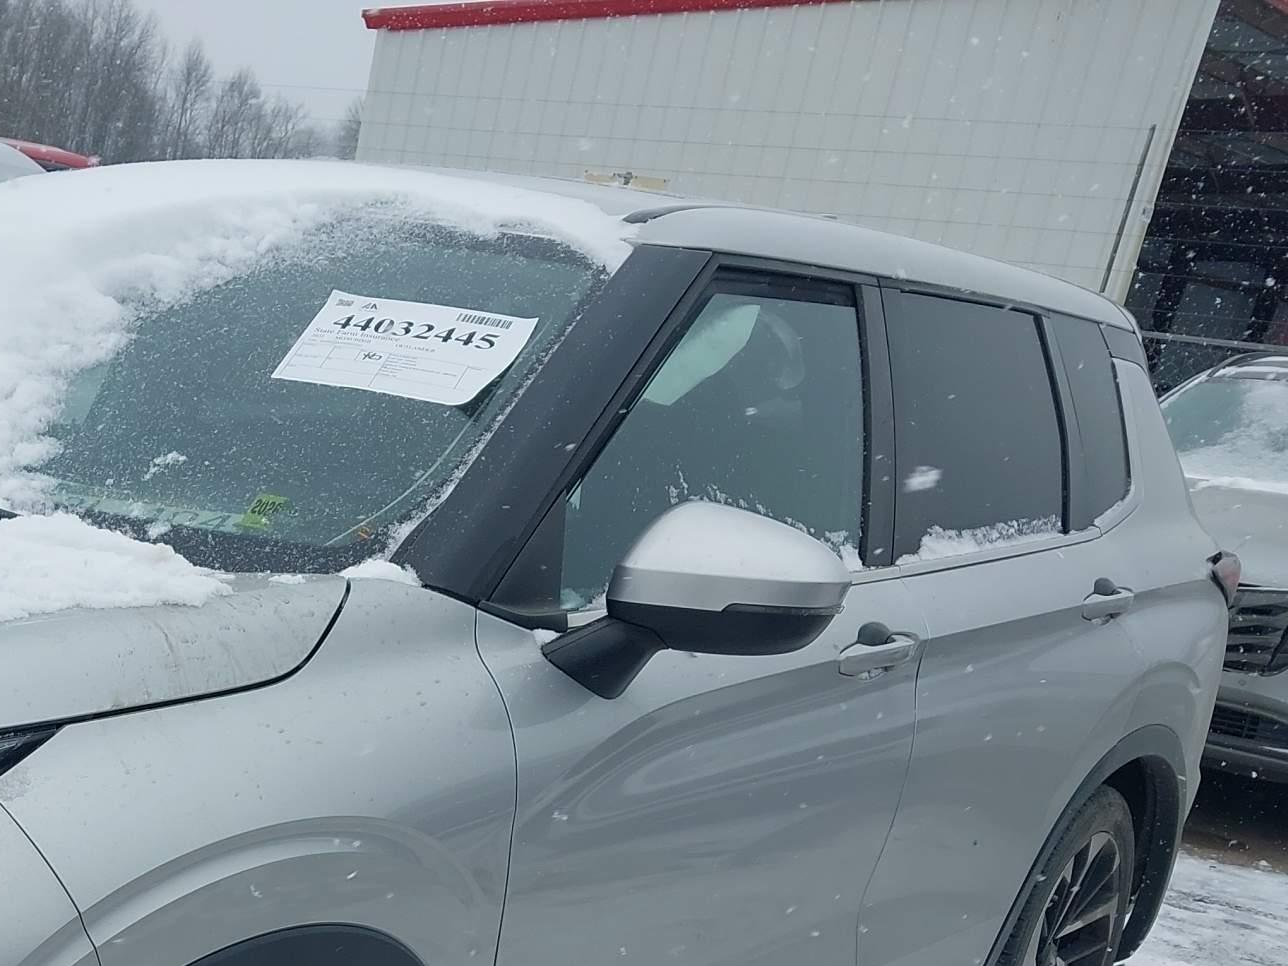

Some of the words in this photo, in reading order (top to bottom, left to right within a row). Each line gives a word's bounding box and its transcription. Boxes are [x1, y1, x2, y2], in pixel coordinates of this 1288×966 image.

[333, 314, 501, 350] 44032445
[337, 329, 358, 337] Farm
[360, 331, 401, 342] Insurance
